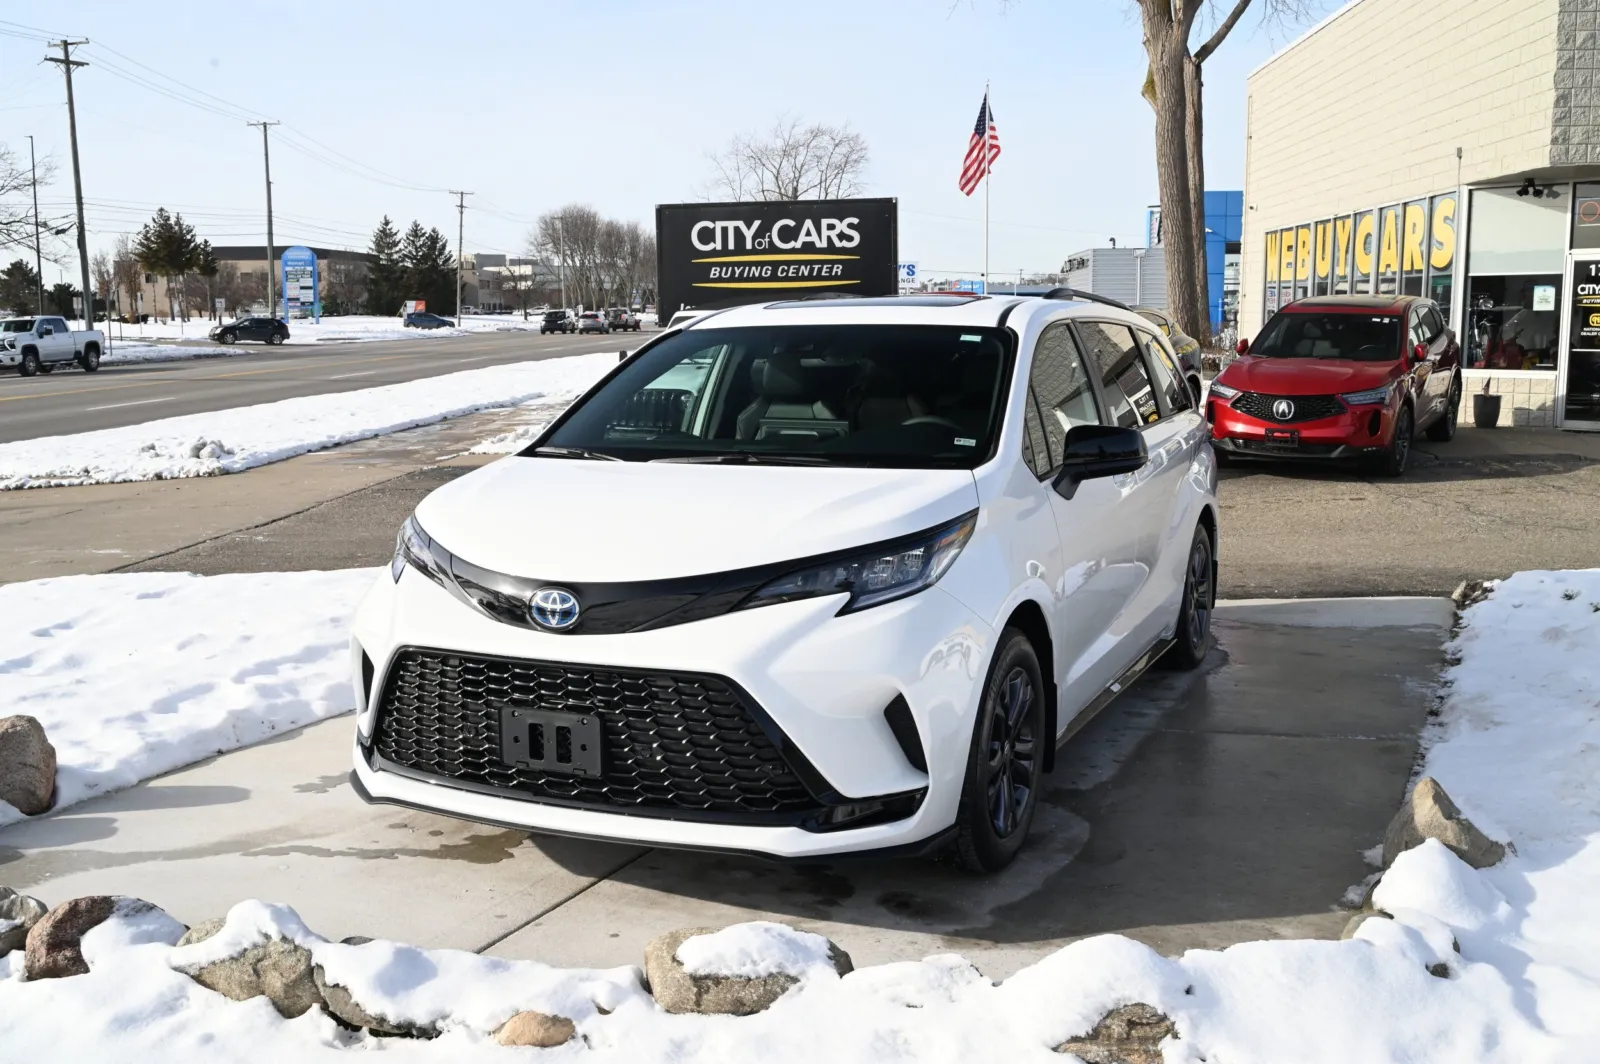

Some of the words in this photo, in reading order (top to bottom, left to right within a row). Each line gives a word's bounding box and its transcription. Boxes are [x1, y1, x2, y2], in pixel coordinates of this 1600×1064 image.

[691, 219, 762, 252] CITY
[754, 232, 771, 250] of
[771, 217, 861, 250] CARS
[709, 265, 772, 279] BUYING
[777, 264, 843, 277] CENTER
